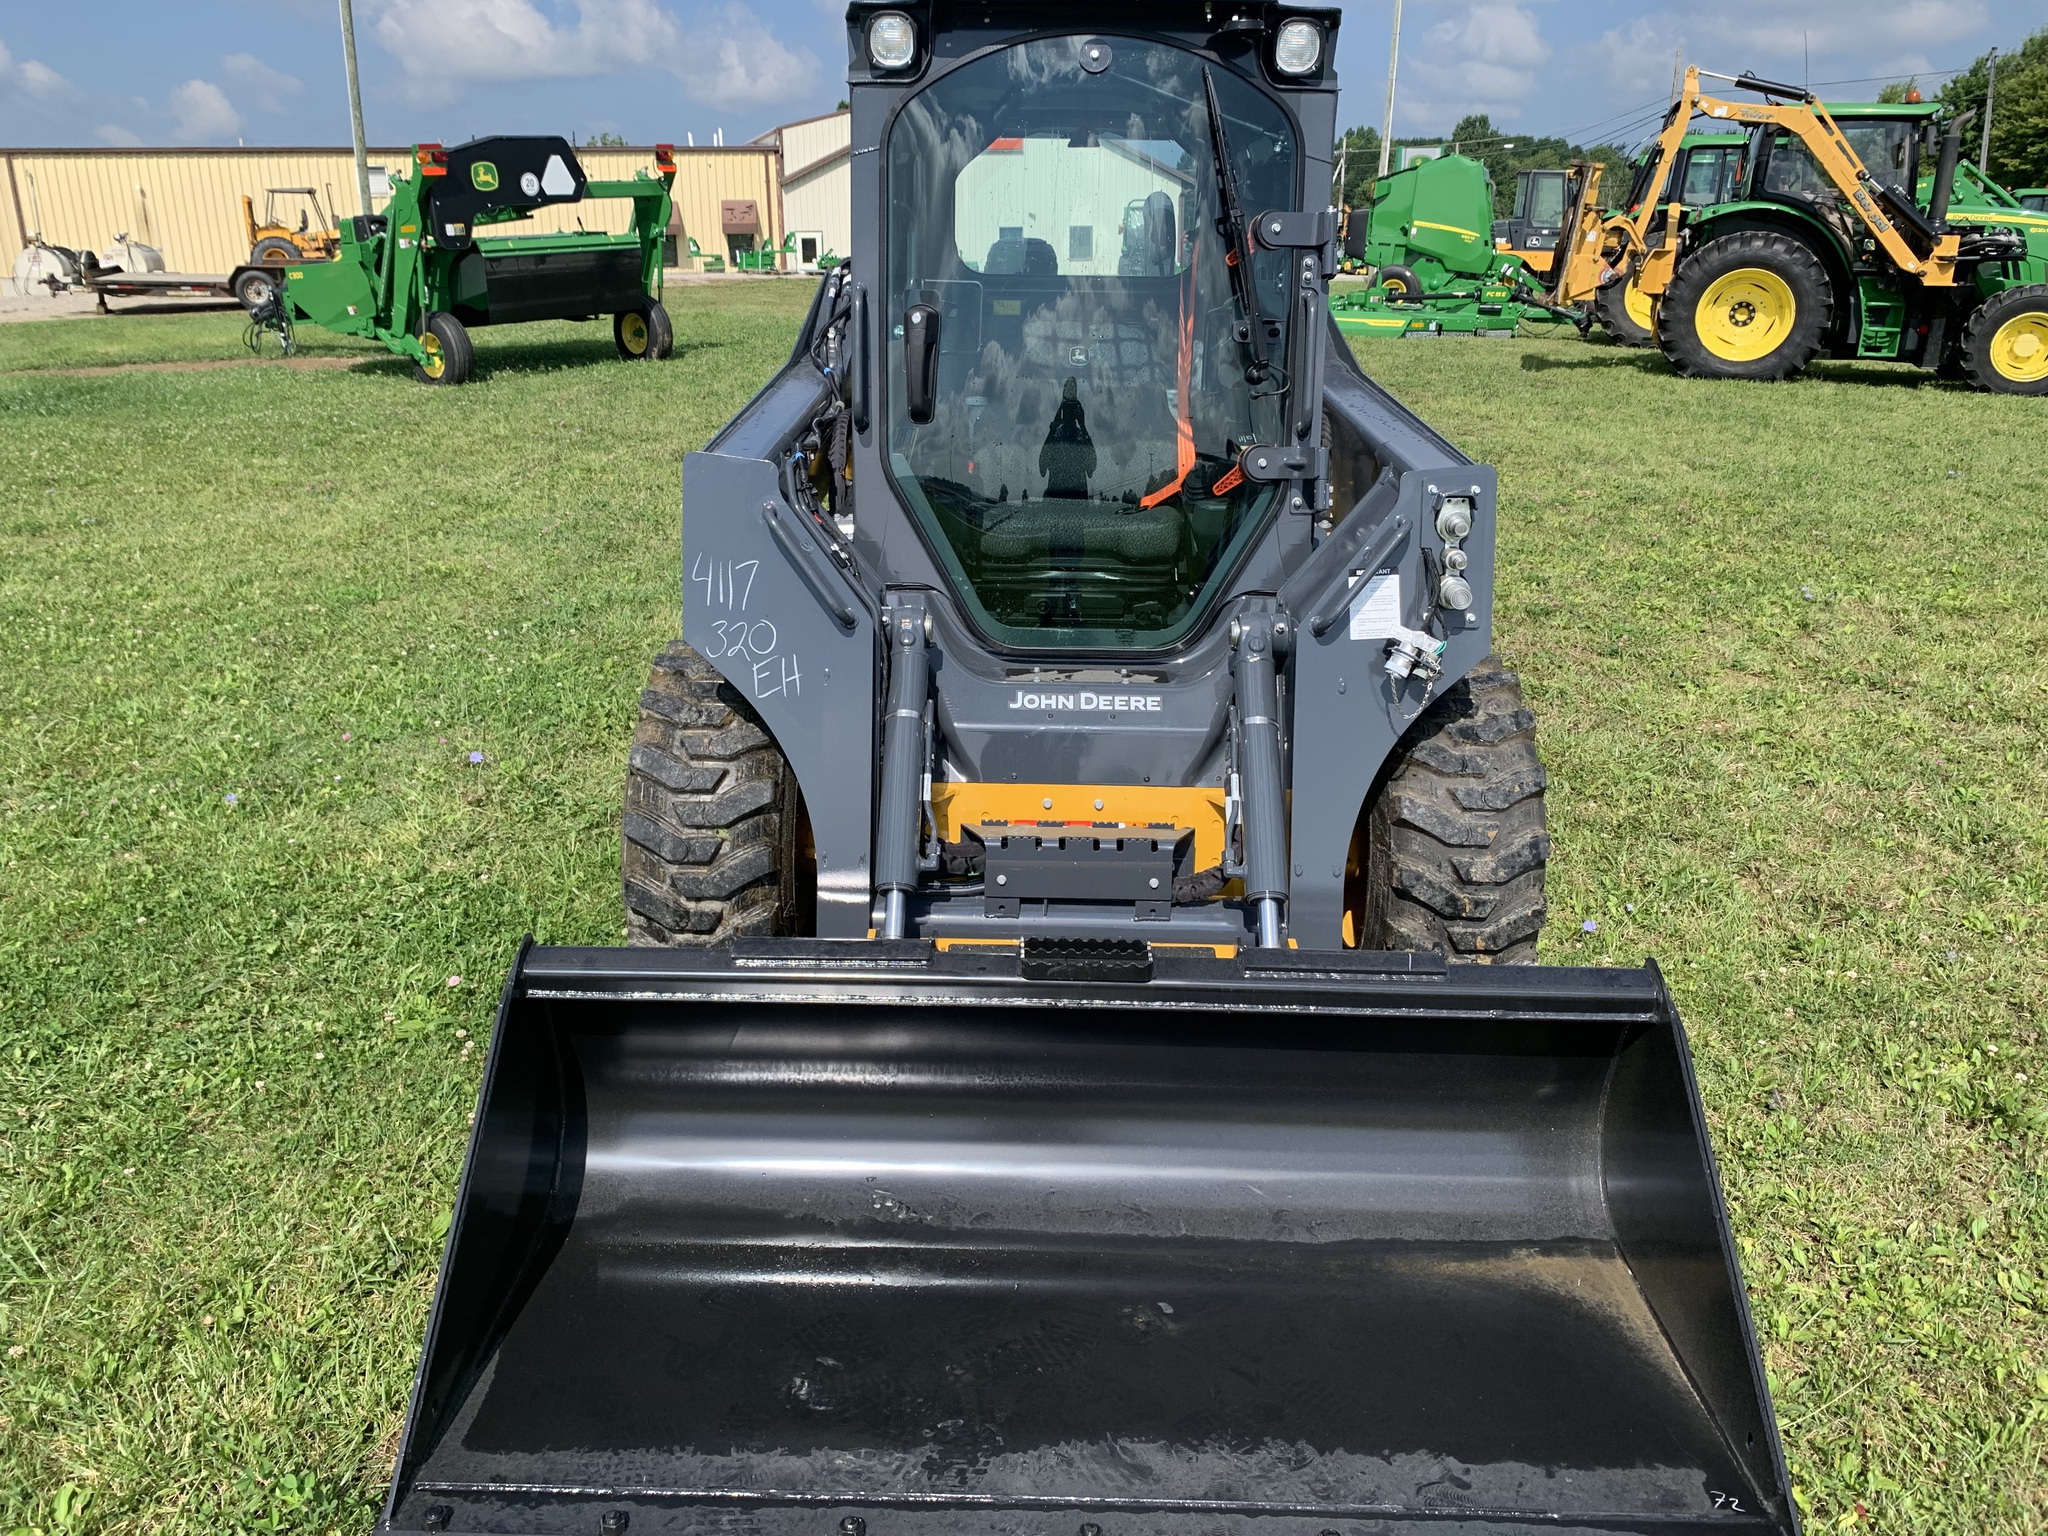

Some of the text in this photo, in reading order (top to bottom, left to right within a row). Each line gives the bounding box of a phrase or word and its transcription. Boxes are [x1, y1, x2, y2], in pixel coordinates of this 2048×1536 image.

[692, 552, 759, 611] 4117
[705, 619, 777, 662] 320
[752, 653, 802, 699] EH
[1009, 691, 1161, 711] JOHN DEERE
[1710, 1490, 1746, 1513] 72
